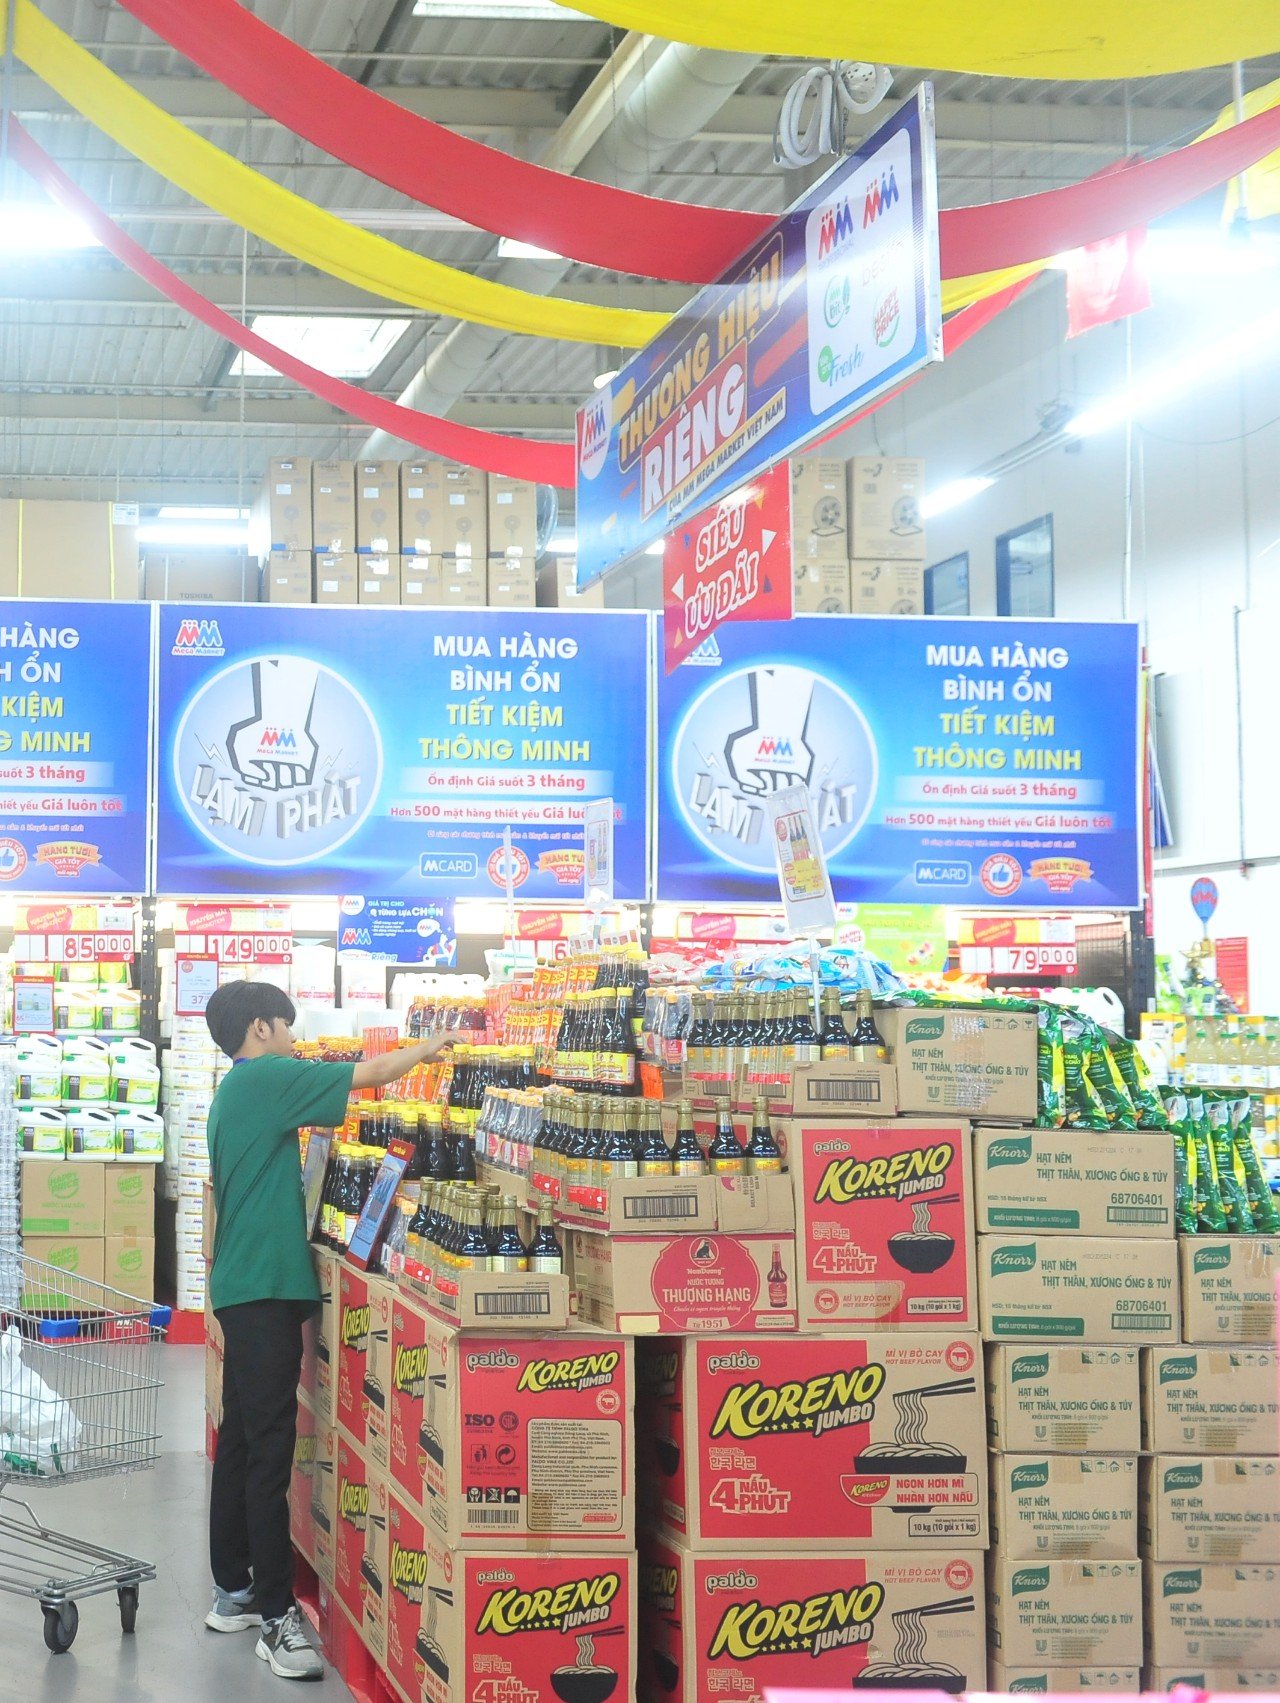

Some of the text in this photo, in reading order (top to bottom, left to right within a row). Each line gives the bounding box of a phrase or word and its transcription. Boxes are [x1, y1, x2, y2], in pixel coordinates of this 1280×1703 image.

[620, 252, 779, 462] THƯƠNG HIỆU
[644, 364, 744, 513] RIÊNG
[697, 463, 715, 484] MEGA
[717, 434, 745, 466] MARKET
[765, 397, 783, 423] NAM
[0, 621, 80, 649] HÀNG
[433, 631, 578, 659] MUA HÀNG
[21, 650, 61, 683] ỔN
[926, 640, 1069, 669] MUA HÀNG
[450, 660, 560, 692] BÌNH ỔN
[943, 670, 1052, 702] BÌNH ỔN
[2, 690, 64, 724] KIỆM
[446, 696, 563, 733] TIẾT KIỆM
[940, 706, 1055, 743] TIẾT KIỆM
[21, 731, 91, 752] MINH
[419, 732, 590, 762] THÔNG MINH
[914, 742, 1082, 771] THÔNG MINH
[26, 766, 34, 778] 3
[39, 765, 85, 782] tháng
[41, 798, 63, 811] Giá
[67, 797, 98, 812] luôn
[813, 1141, 851, 1155] paldo
[989, 1146, 1030, 1158] Knorr
[1037, 1153, 1051, 1165] HẠT
[815, 1142, 955, 1205] KORENO
[896, 1173, 945, 1200] JUMBO
[1037, 1169, 1054, 1181] THỊT
[1086, 1170, 1117, 1181] XƯƠNG
[1143, 1172, 1149, 1181] &
[1111, 1193, 1162, 1205] 68706401
[1196, 1254, 1230, 1265] Knorr
[663, 1287, 751, 1304] THƯỢNG HẠNG
[702, 1320, 723, 1328] 1951
[708, 1350, 760, 1375] paldo
[1014, 1361, 1047, 1374] Knorr
[709, 1363, 886, 1439] KORENO
[815, 1402, 875, 1436] JUMBO
[710, 1479, 738, 1511] 4
[850, 1480, 887, 1496] KORENO
[897, 1479, 924, 1488] NGON
[928, 1479, 948, 1488] HƠN
[928, 1492, 949, 1503] HƠN
[923, 1524, 931, 1532] kg
